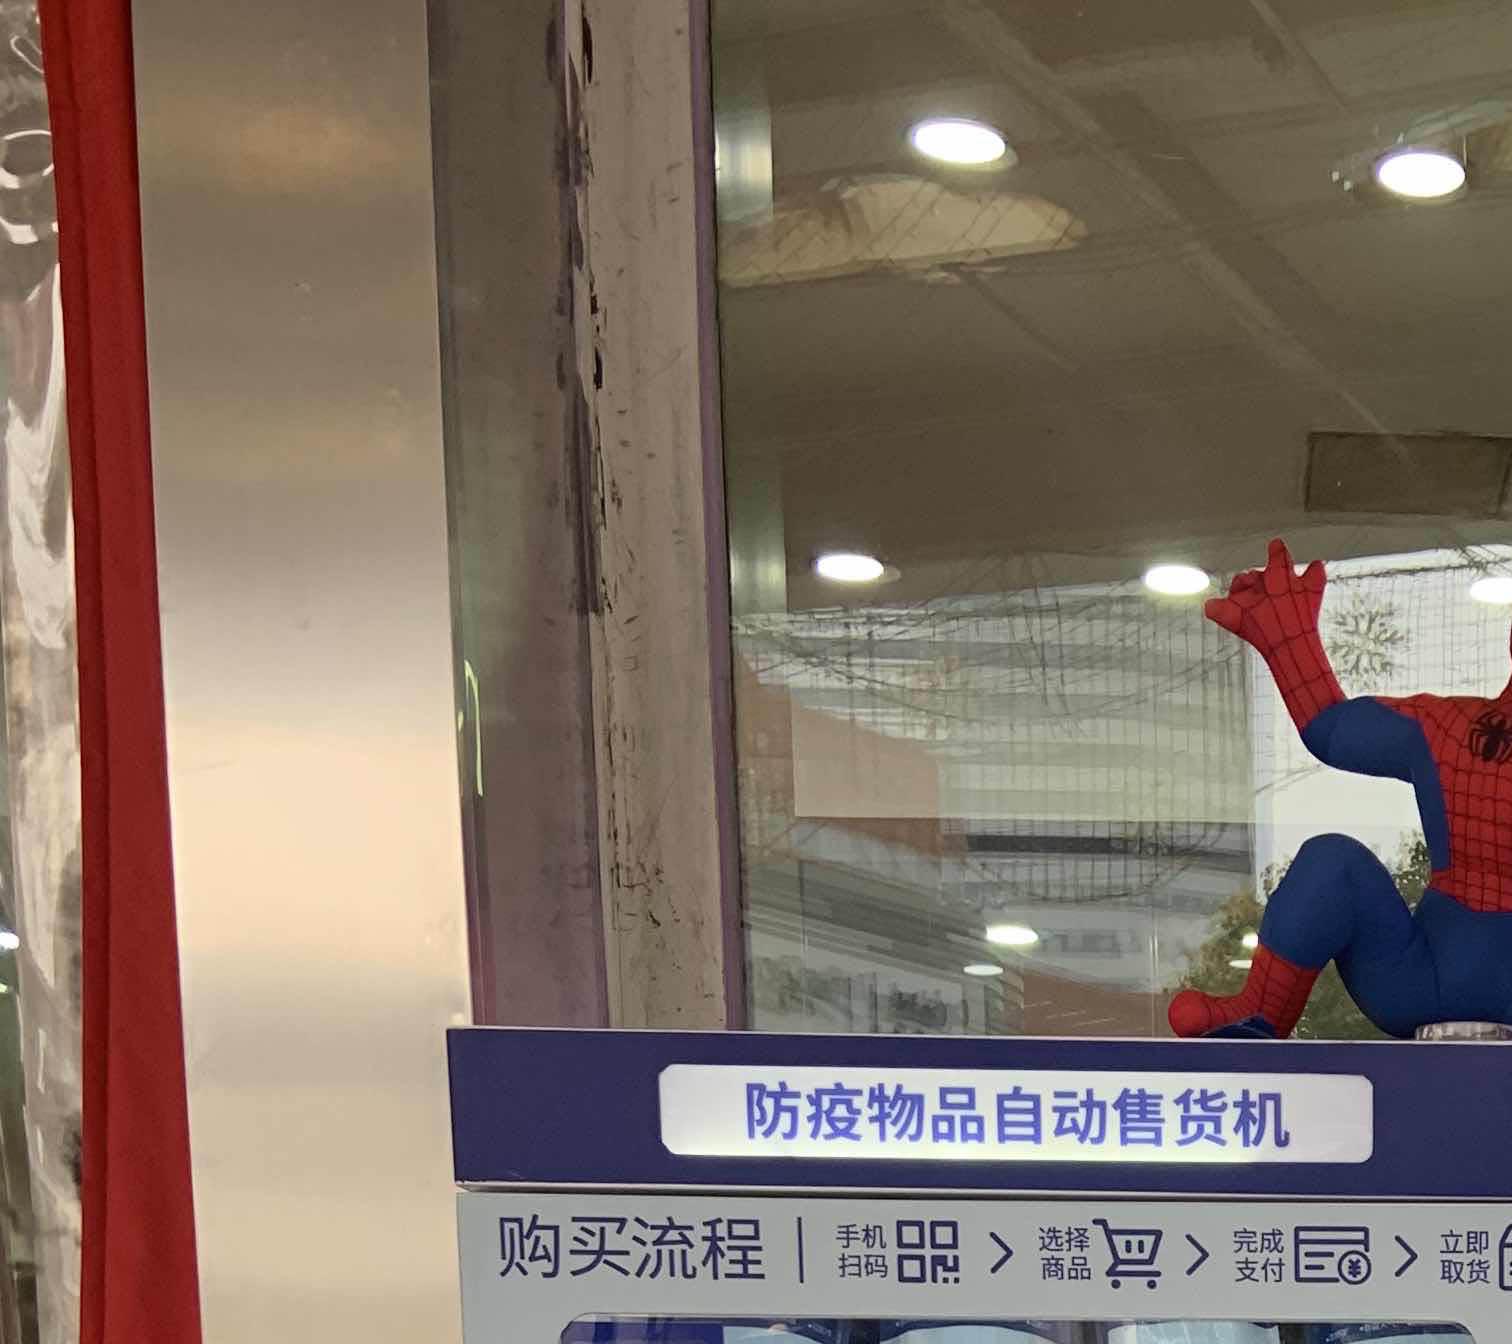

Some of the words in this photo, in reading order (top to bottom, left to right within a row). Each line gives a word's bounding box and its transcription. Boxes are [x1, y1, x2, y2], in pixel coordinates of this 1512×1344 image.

[744, 1082, 1291, 1149] 防疫物品自动售货机
[498, 1216, 766, 1283] 购买流程
[835, 1223, 887, 1251] 手机
[1037, 1224, 1090, 1253] 选择
[1232, 1227, 1284, 1255] 完成
[1438, 1230, 1490, 1257] 立即
[837, 1253, 890, 1281] 扫码
[1041, 1254, 1091, 1282] 商品
[1234, 1256, 1285, 1283] 支付
[1439, 1257, 1491, 1285] 取货
